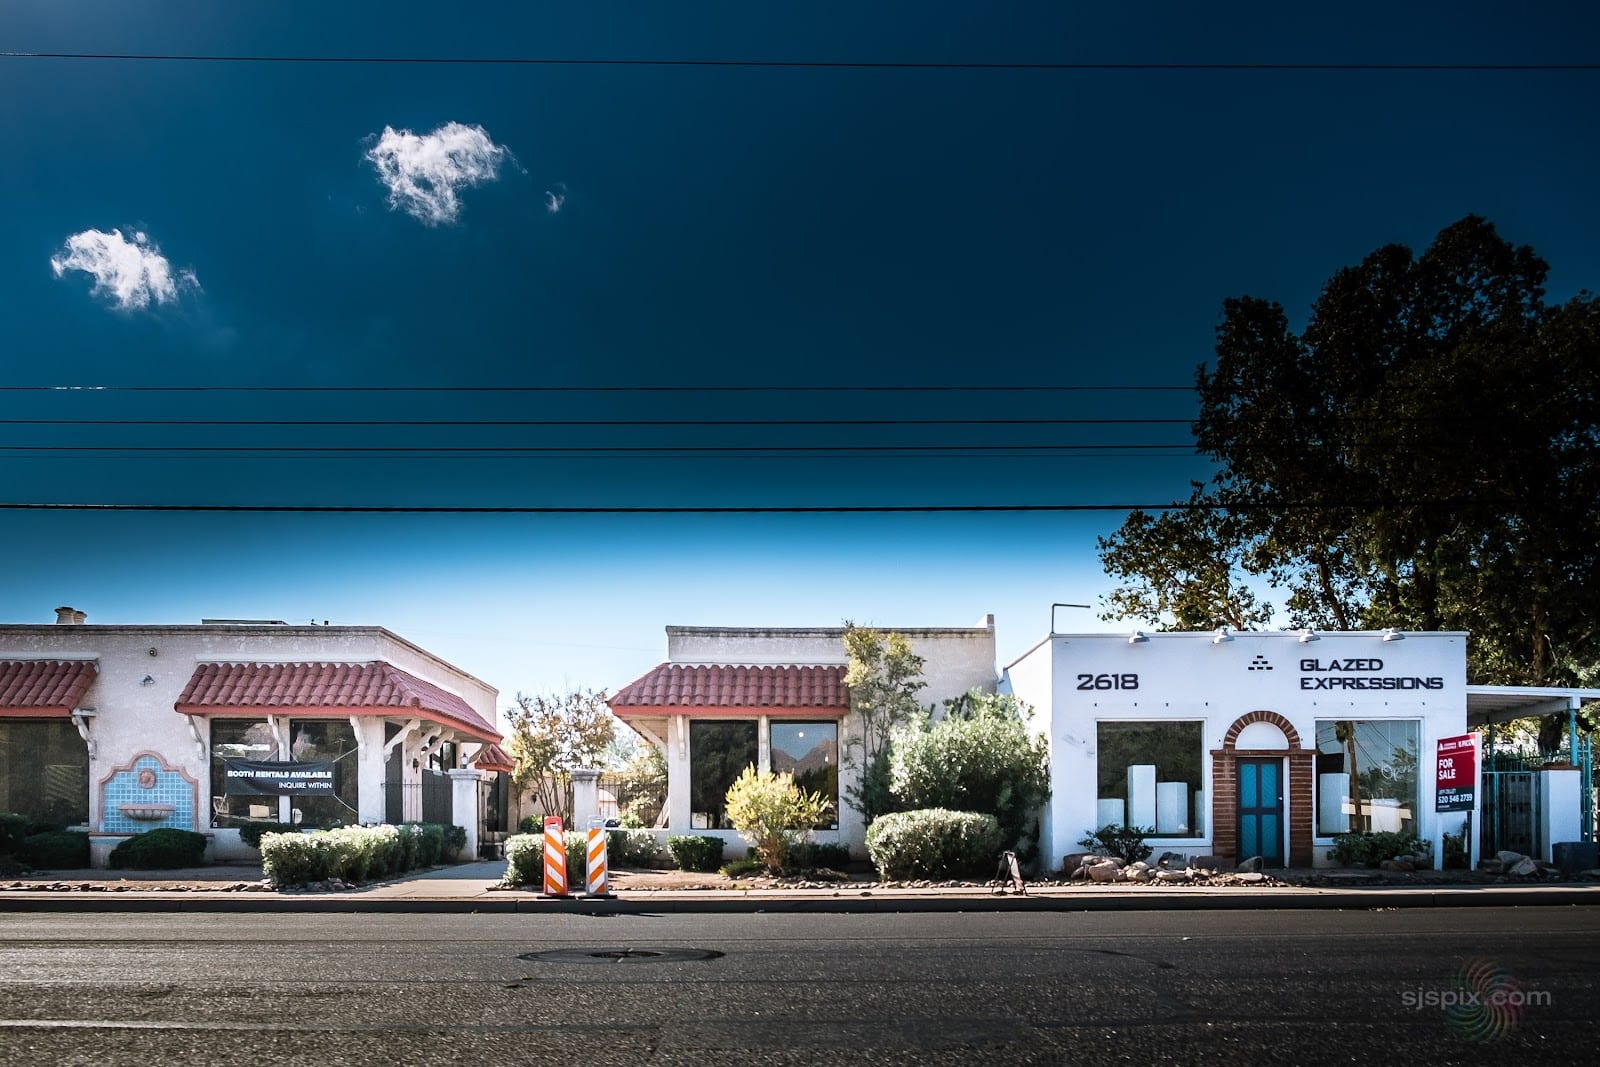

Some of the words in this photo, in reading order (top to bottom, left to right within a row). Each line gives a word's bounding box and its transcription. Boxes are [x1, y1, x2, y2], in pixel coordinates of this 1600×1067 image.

[1300, 658, 1384, 671] GLAZED
[1076, 673, 1139, 690] 2618
[1300, 677, 1444, 690] EXPRESSIONS
[1438, 758, 1453, 769] FOR
[227, 770, 254, 778] BOOTH
[255, 770, 289, 778] RENTALS
[1438, 769, 1456, 780] SALE
[278, 781, 306, 789] INQUIRE
[307, 781, 332, 789] WITHIN
